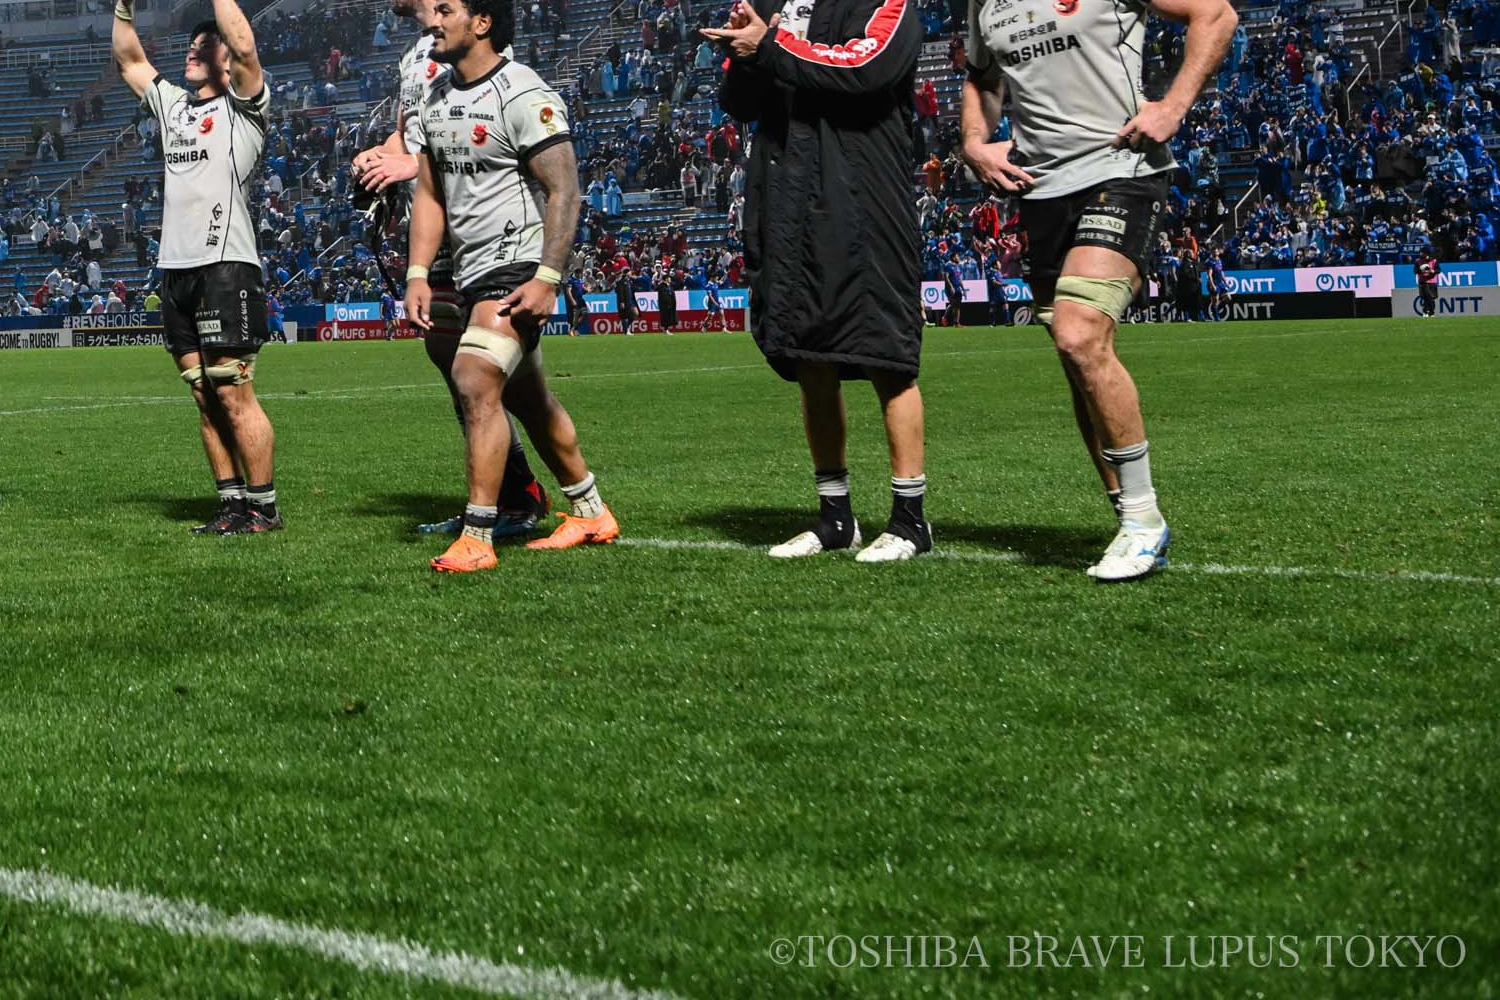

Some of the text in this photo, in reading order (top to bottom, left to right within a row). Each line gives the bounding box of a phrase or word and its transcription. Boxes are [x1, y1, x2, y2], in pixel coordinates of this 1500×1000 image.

[1002, 34, 1082, 68] TOSHIBA
[165, 149, 209, 164] TOSHIBA
[1241, 277, 1276, 292] NTT
[1337, 274, 1373, 289] NTT
[1438, 270, 1476, 287] NTT
[1232, 302, 1275, 319] NTT
[1439, 296, 1483, 314] NTT
[63, 313, 148, 329] #REVSHOUSE
[348, 308, 369, 320] NTT
[613, 319, 648, 332] MFG
[22, 338, 29, 349] TO
[29, 332, 60, 349] RUGBY!
